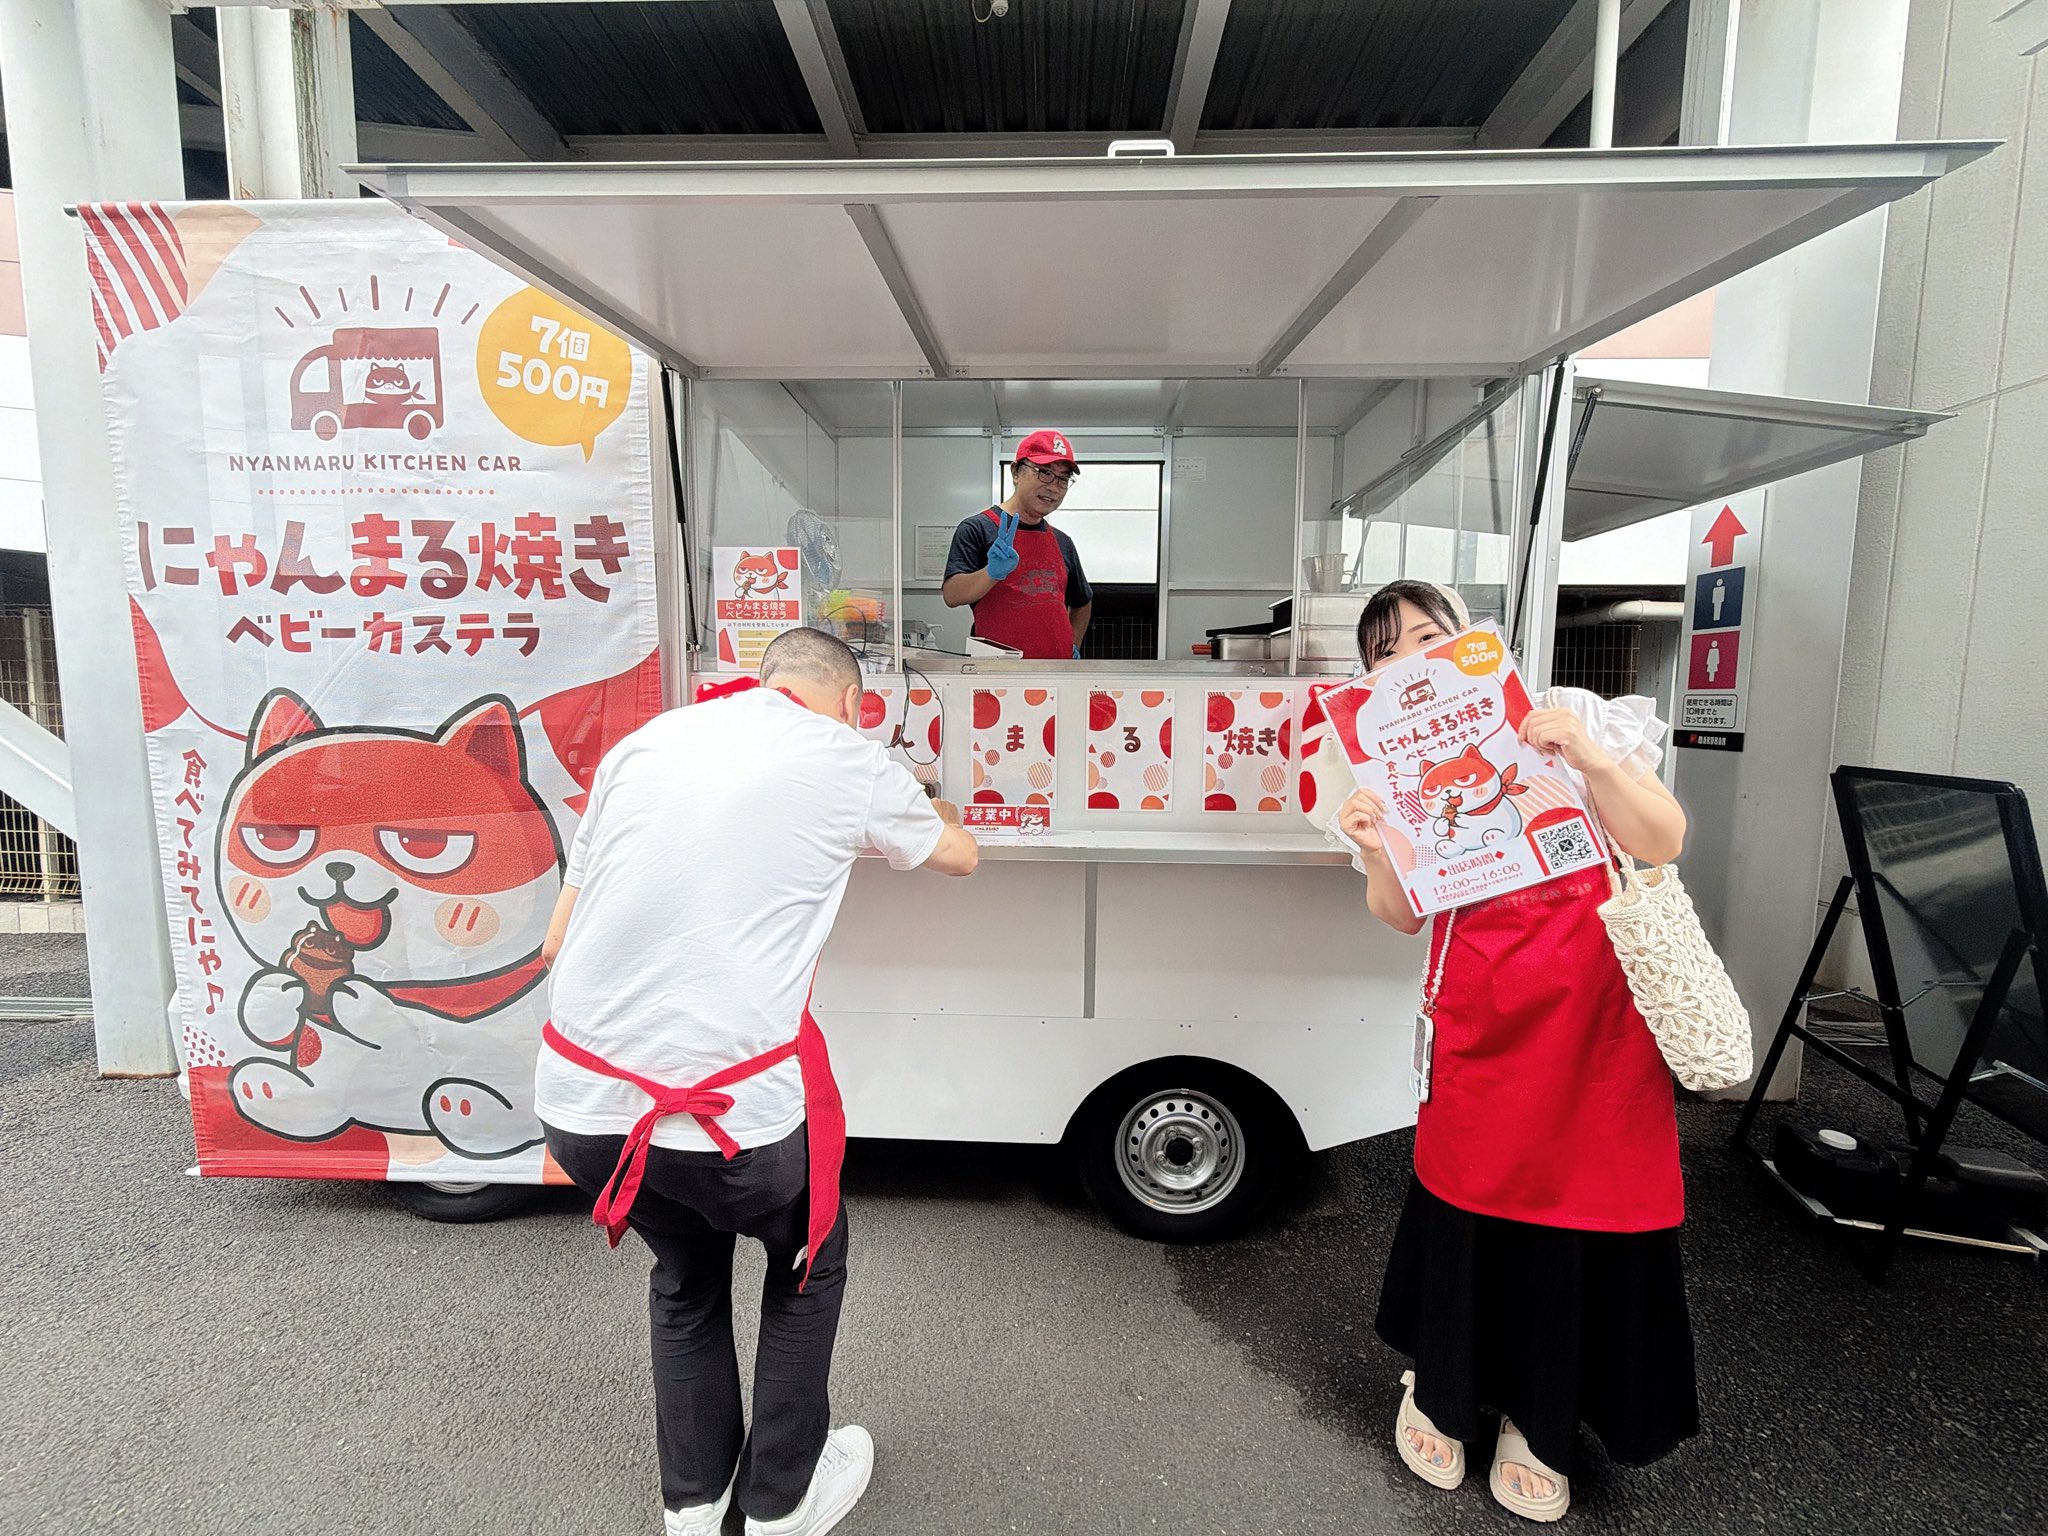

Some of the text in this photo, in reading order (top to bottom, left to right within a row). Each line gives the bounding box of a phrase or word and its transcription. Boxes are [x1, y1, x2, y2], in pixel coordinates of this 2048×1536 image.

[530, 315, 590, 361] 7個
[496, 353, 609, 408] 500円
[229, 453, 522, 472] NYANMARU KITCHEN CAR
[137, 512, 630, 604] にゃんまる焼き
[726, 602, 786, 610] にゃんまる焼き
[726, 610, 787, 619] ベビーカステラ
[226, 610, 540, 657] ベビーカステラ
[1466, 641, 1487, 653] 7個
[1461, 651, 1498, 667] 500円
[1379, 686, 1479, 732] NYANMARU KITCHEN CAR
[890, 724, 915, 748] ん
[1005, 724, 1026, 752] ま
[1123, 726, 1143, 753] る
[1378, 697, 1494, 756] にゃんまる焼き
[1223, 726, 1277, 756] 焼き
[1406, 726, 1480, 760] ベビーカステラ
[970, 808, 1011, 821] 営業中
[1448, 853, 1495, 875] 出店時間
